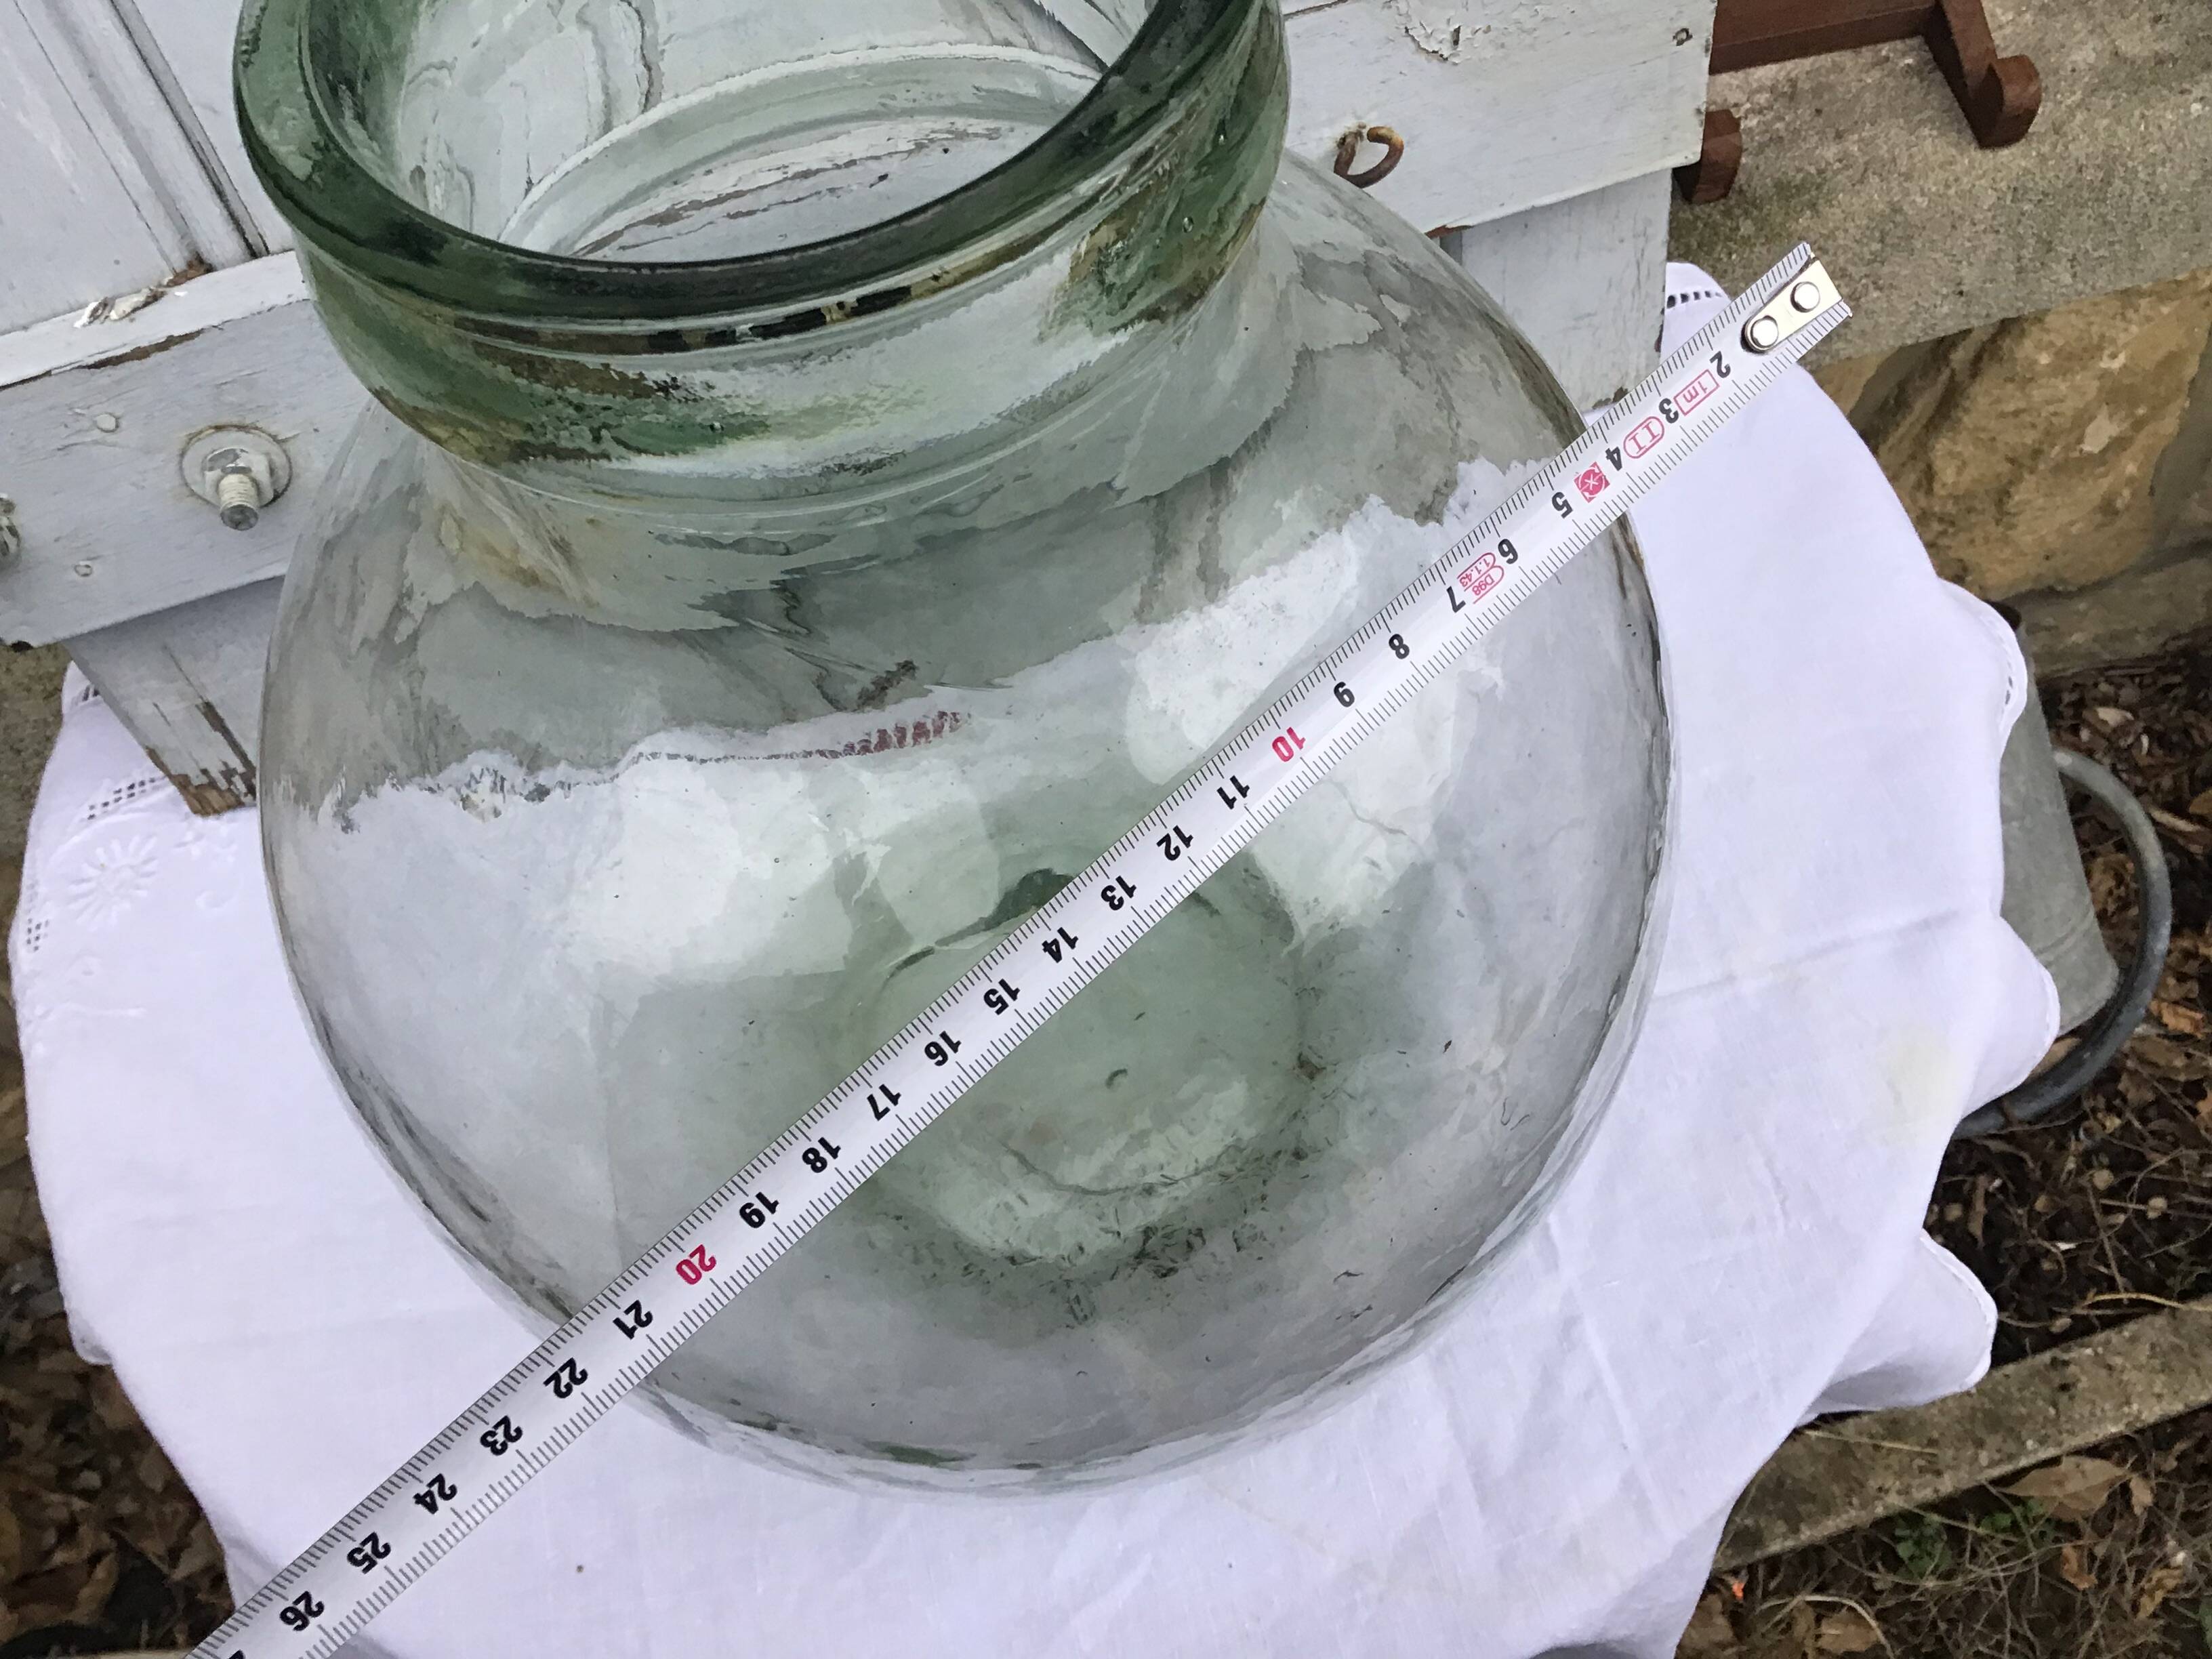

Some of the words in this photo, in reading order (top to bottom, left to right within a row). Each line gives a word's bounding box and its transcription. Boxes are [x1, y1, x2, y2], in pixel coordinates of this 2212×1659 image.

[1711, 352, 1730, 377] 2
[1659, 398, 1678, 423] 3
[1605, 447, 1622, 470] 4
[1552, 492, 1572, 518] 5
[1498, 539, 1517, 564] 6
[1447, 586, 1465, 613] 7
[1389, 634, 1409, 659] 8
[1334, 682, 1354, 707] 9
[1272, 727, 1305, 762] 10
[1217, 775, 1250, 809] 11
[1157, 825, 1193, 861] 12
[1101, 876, 1136, 910] 13
[1042, 927, 1078, 963] 14
[984, 979, 1020, 1015] 15
[924, 1031, 961, 1066] 16
[867, 1084, 901, 1121] 17
[802, 1137, 841, 1173] 18
[739, 1192, 779, 1228] 19
[675, 1244, 716, 1285] 20
[613, 1300, 653, 1339] 21
[543, 1357, 588, 1399] 22
[480, 1415, 523, 1456] 23
[414, 1473, 457, 1514] 24
[346, 1532, 391, 1574] 25
[279, 1591, 325, 1631] 26
